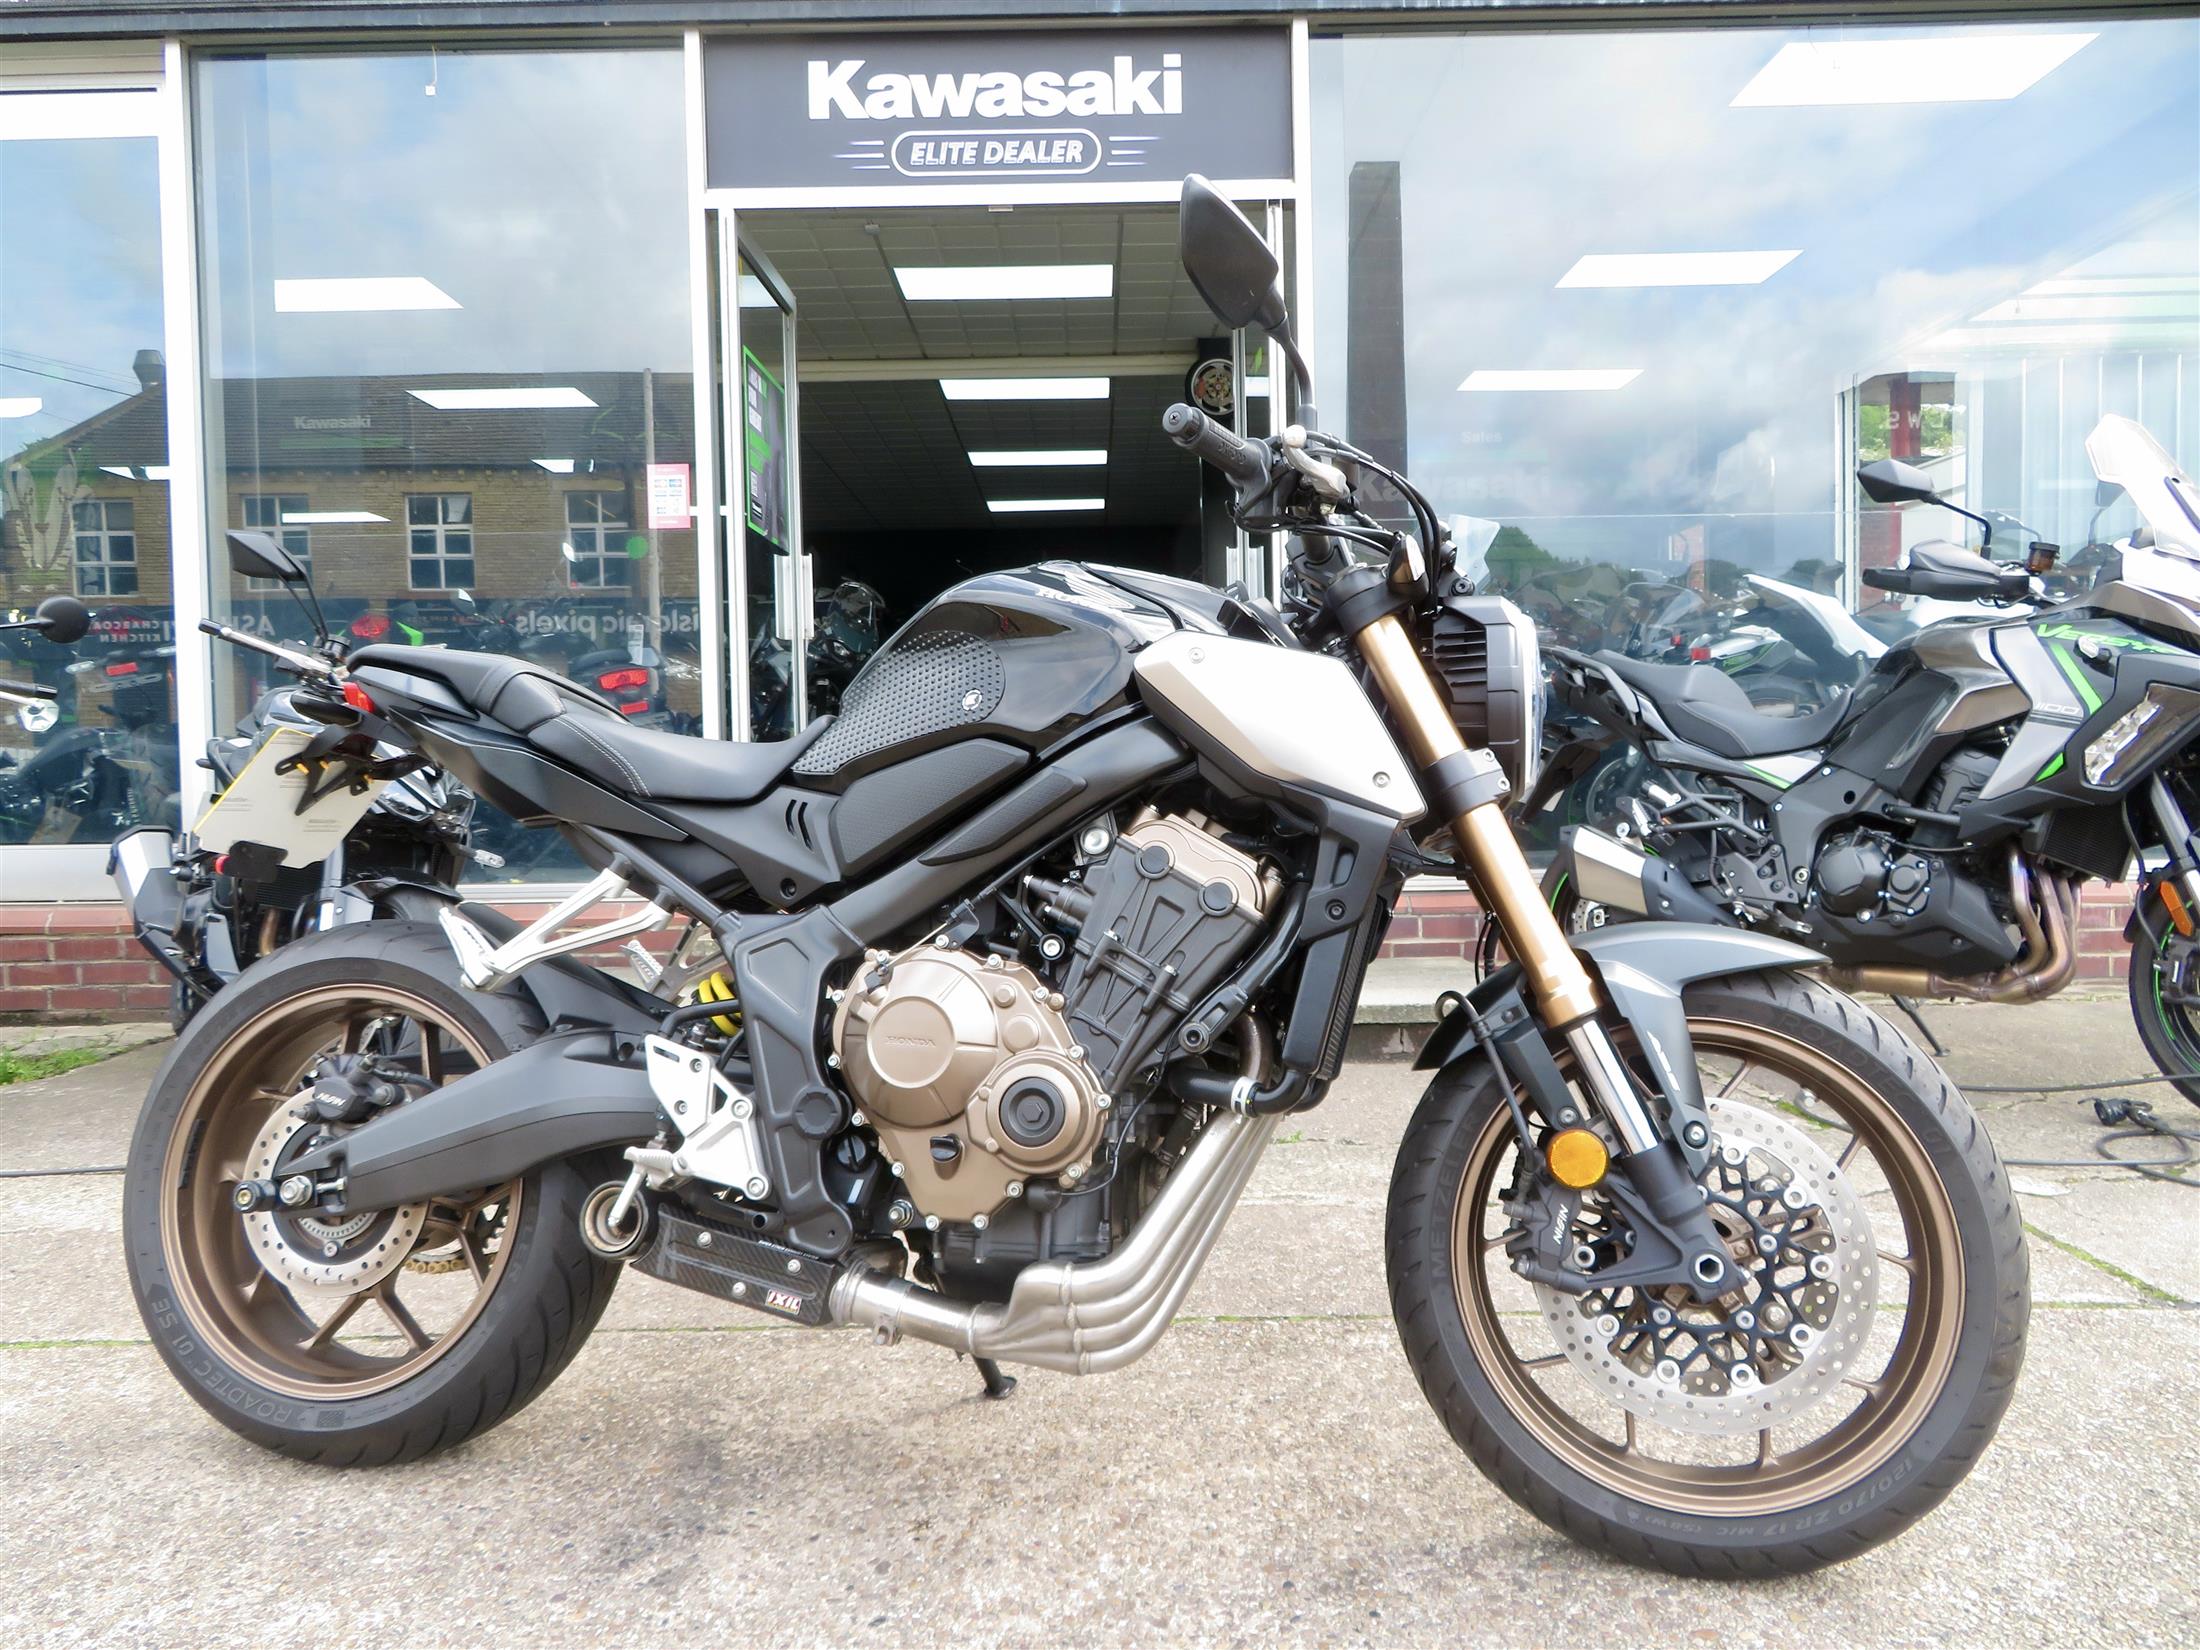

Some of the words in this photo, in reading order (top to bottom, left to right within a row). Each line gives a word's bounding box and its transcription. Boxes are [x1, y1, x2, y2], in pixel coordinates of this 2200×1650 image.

[807, 53, 1183, 120] Kawasaki
[909, 140, 978, 165] ELITE
[984, 138, 1085, 165] DEALER
[293, 415, 372, 430] Kawasaki
[882, 1034, 936, 1048] HONDA
[767, 1290, 800, 1310] IXIL
[152, 1297, 179, 1330] SE
[193, 1359, 292, 1422] ROADTEC
[1837, 1457, 1913, 1515] 120/70
[1761, 1522, 1788, 1537] 17
[1794, 1509, 1832, 1531] ZR
